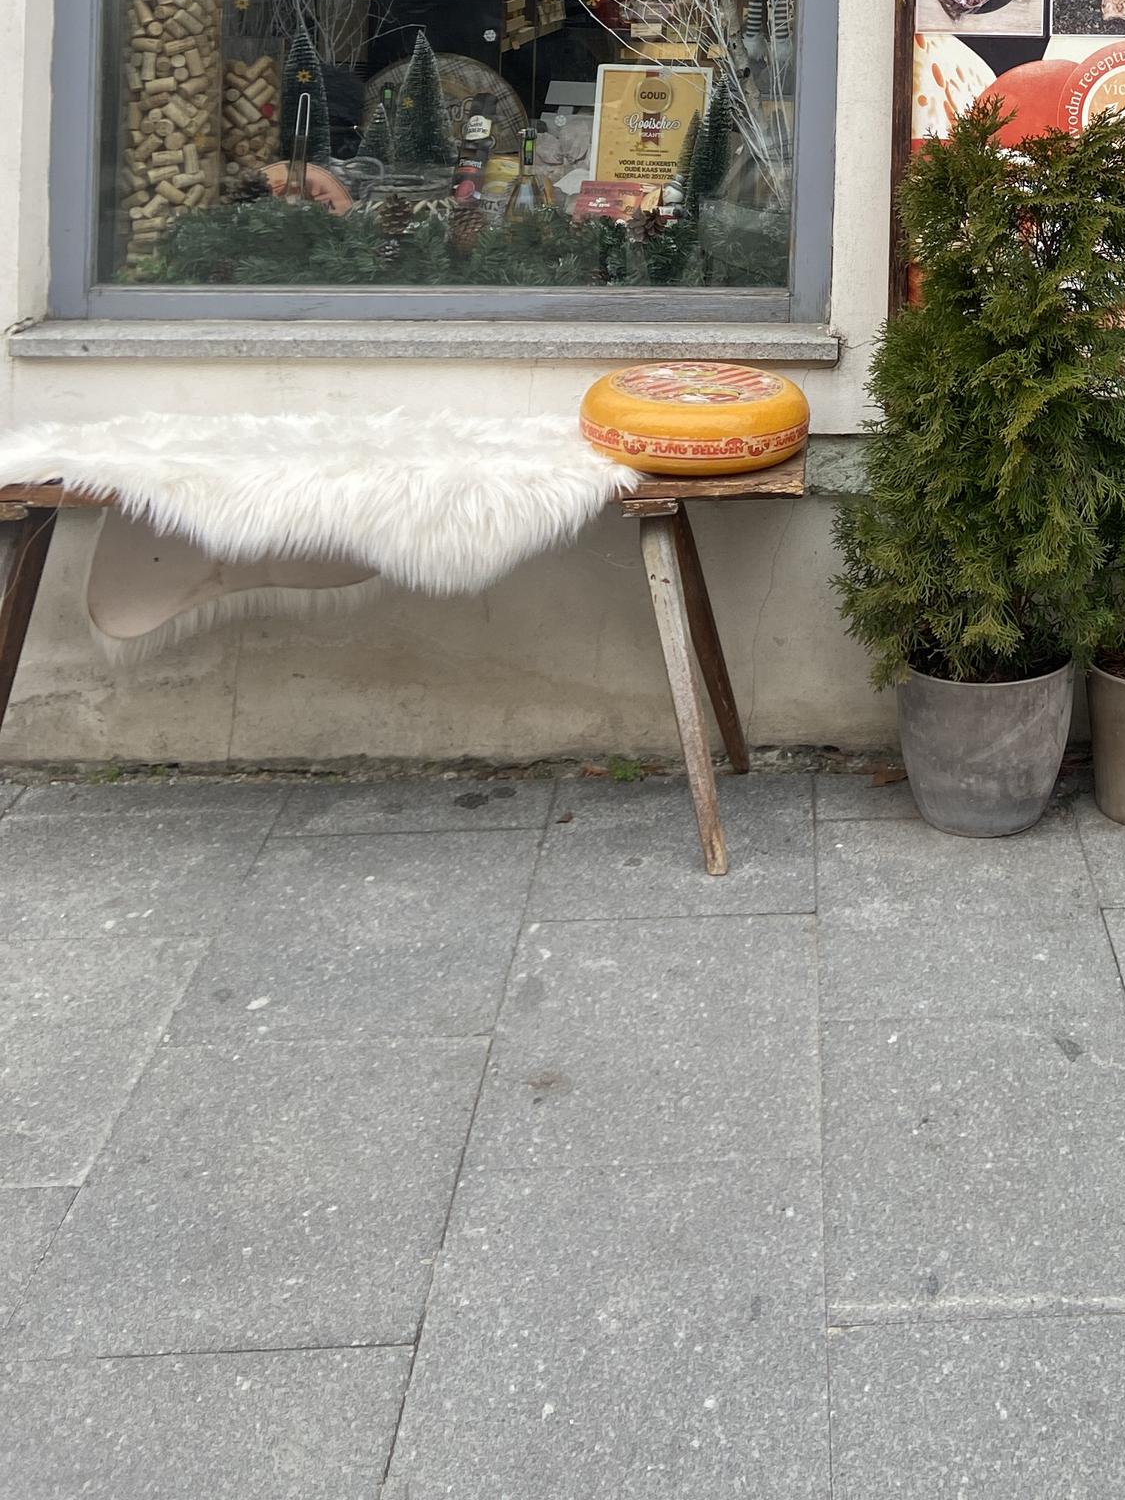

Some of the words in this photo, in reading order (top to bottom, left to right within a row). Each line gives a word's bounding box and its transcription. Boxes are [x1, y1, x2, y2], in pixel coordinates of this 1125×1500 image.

[640, 91, 667, 100] GOUD
[624, 113, 681, 133] Gooische
[1064, 90, 1083, 140] vodní
